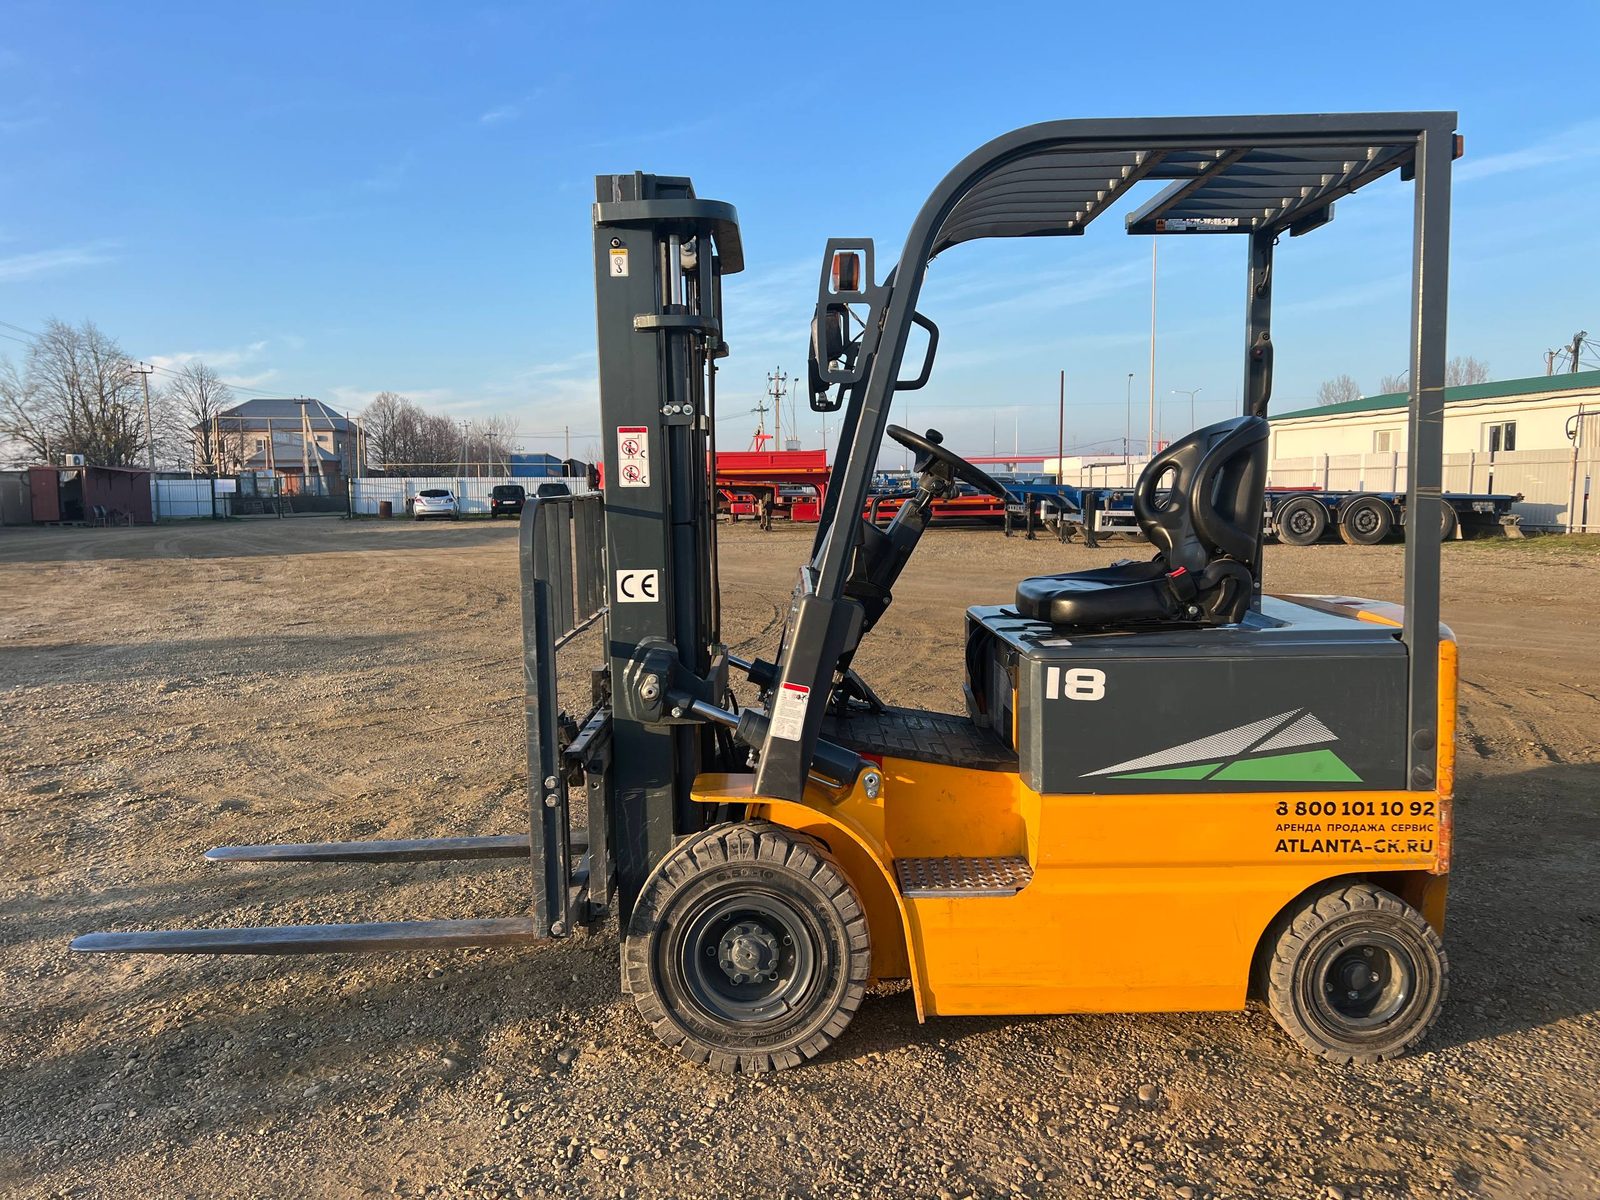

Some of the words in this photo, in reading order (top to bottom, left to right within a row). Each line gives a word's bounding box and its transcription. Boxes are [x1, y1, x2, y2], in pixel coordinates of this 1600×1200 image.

[621, 574, 655, 598] CE
[1046, 666, 1106, 701] 18
[1276, 801, 1289, 816] 8
[1295, 801, 1337, 816] 800
[1342, 801, 1376, 816] 101
[1380, 801, 1404, 816] 10
[1409, 801, 1435, 817] 92
[1276, 824, 1322, 833] АРЕНДА
[1327, 824, 1386, 833] ПРОДАЖА
[1391, 824, 1434, 832] СЕРВИС
[1275, 839, 1434, 853] ATLANTA-CK.RU
